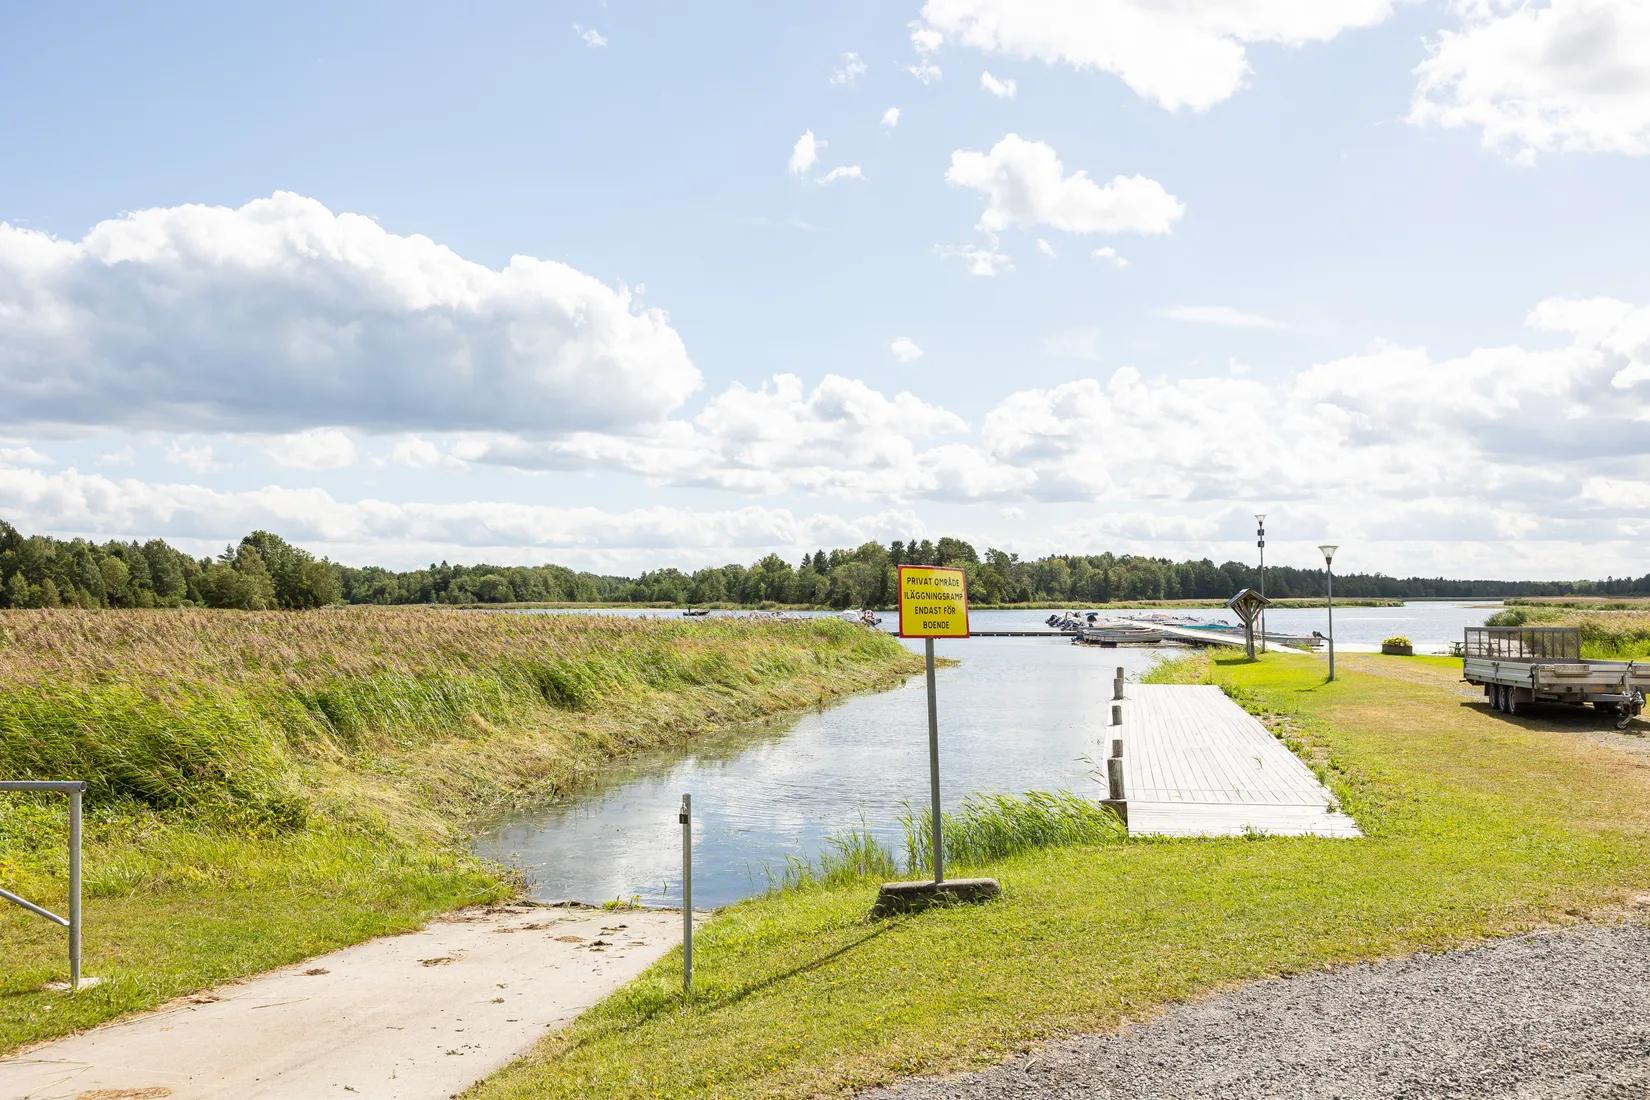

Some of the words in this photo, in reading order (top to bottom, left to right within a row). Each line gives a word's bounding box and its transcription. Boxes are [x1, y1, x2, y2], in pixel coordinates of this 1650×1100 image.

[906, 576, 932, 586] PRIVAT
[934, 576, 960, 587] OMRÅDE
[904, 590, 963, 600] ILÄGGNINGSRAMP
[914, 606, 942, 614] ENDAST
[944, 605, 956, 614] FÖR
[923, 621, 949, 629] BOENDE
